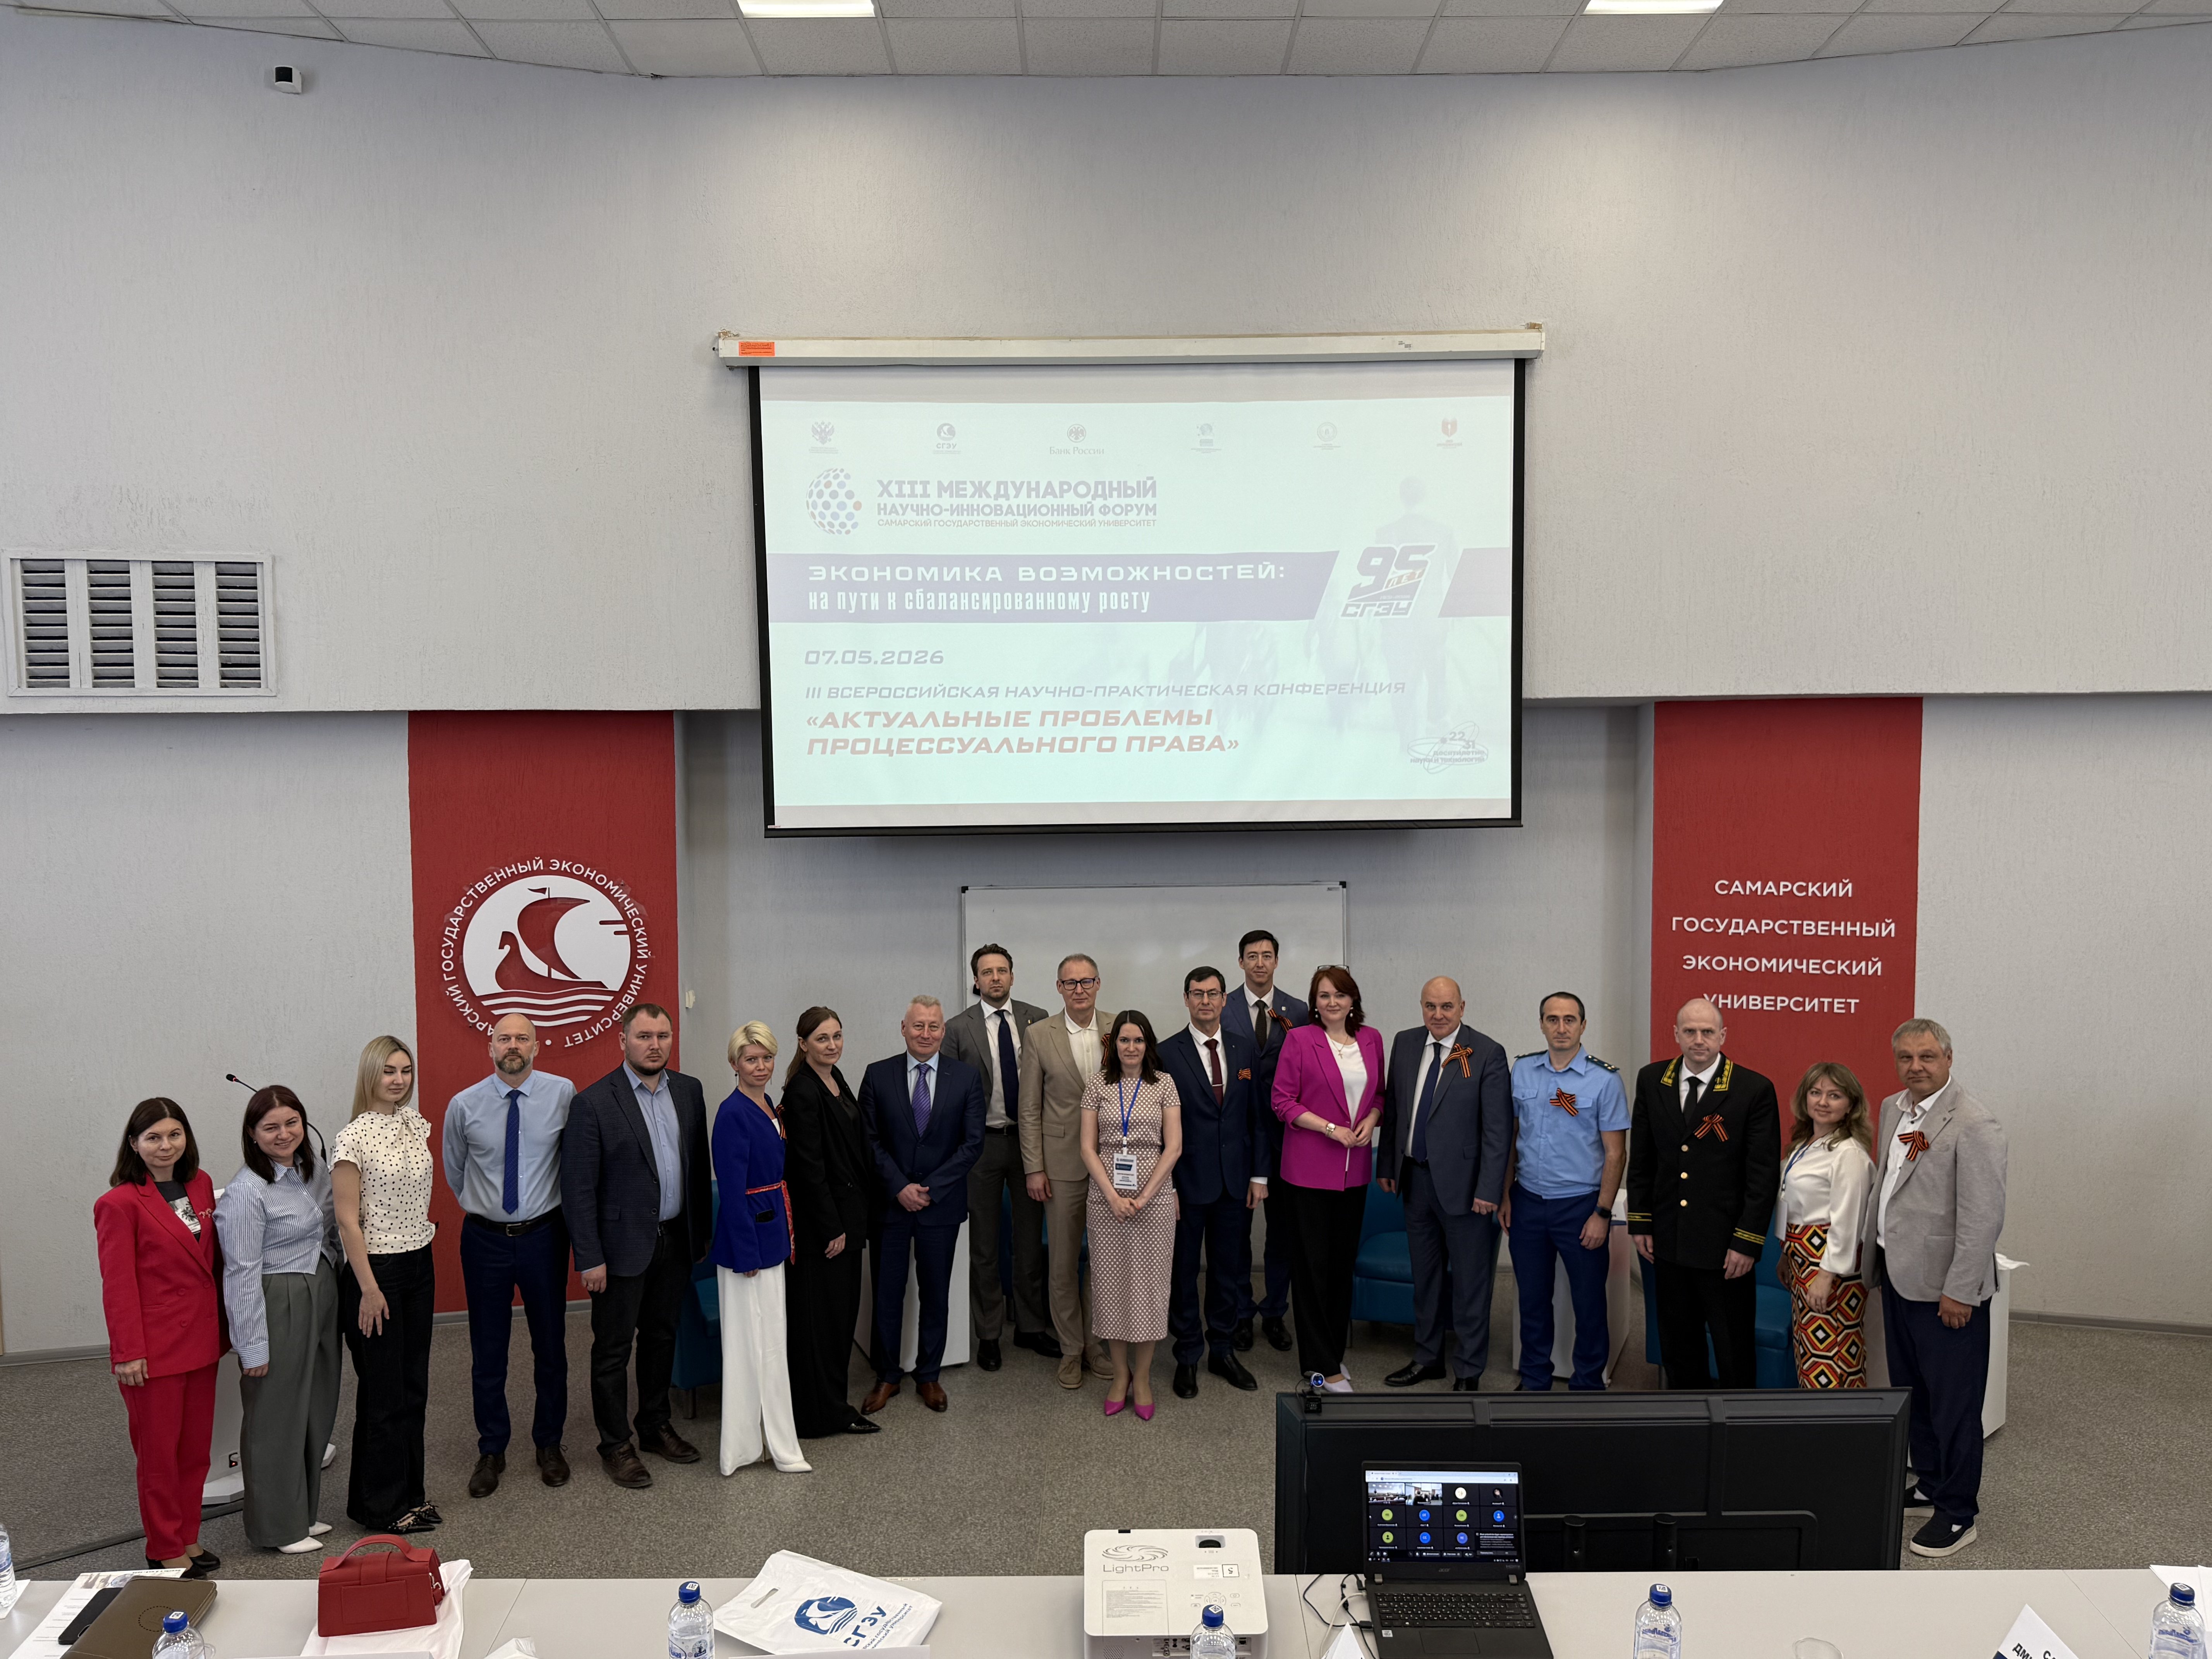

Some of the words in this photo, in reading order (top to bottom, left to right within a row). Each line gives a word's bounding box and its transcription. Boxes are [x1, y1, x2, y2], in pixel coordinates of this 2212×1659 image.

[1049, 446, 1071, 455] Банк
[1073, 446, 1104, 455] России
[876, 479, 931, 498] XIII
[937, 476, 1157, 501] МЕЖДУНАРОДНЫЙ
[877, 501, 1094, 519] НАУЧНО-ИННОВАЦИОННЫЙ
[1098, 503, 1157, 516] ФОРУМ
[877, 519, 932, 527] САМАРСКИЙ
[934, 519, 1018, 528] ГОСУДАРСТВЕННЫЙ
[1020, 519, 1096, 527] ЭКОНОМИЧЕСКИЙ
[1098, 519, 1157, 527] УНИВЕРСИТЕТ
[809, 566, 1003, 581] ЭКОНОМИКА
[1018, 562, 1284, 581] ВОЗМОЖНОСТЕЙ:
[1347, 544, 1436, 601] 95
[809, 591, 828, 610] на
[837, 591, 879, 613] пути
[888, 592, 896, 610] к
[904, 588, 1090, 613] сбалансированному
[1099, 591, 1150, 613] росту
[1341, 601, 1413, 617] СГЭУ
[804, 650, 944, 665] 07.05.2026
[805, 687, 821, 699] III
[827, 683, 1000, 699] ВСЕРОССИЙСКАЯ
[1005, 684, 1248, 698] НАУЧНО-ПРАКТИЧЕСКАЯ
[1253, 682, 1406, 696] КОНФЕРЕНЦИЯ
[806, 711, 1031, 728] «АКТУАЛЬНЫЕ
[1039, 709, 1212, 727] ПРОБЛЕМЫ
[807, 737, 1117, 757] ПРОЦЕССУАЛЬНОГО
[1125, 735, 1239, 752] ПРАВА»
[1449, 731, 1465, 741] 22
[1714, 878, 1853, 898] САМАРСКИЙ
[441, 856, 544, 981] ГОСУДАРСТВЕННЫЙ
[549, 859, 651, 959] ЭКОНОМИЧЕСКИЙ
[1671, 916, 1896, 938] ГОСУДАРСТВЕННЫЙ
[1682, 955, 1882, 976] ЭКОНОМИЧЕСКИЙ
[445, 984, 495, 1036] АРСКИЙ
[564, 963, 647, 1048] УНИВЕРСИТЕТ
[1703, 993, 1860, 1013] УНИВЕРСИТЕТ
[1103, 1564, 1169, 1574] LightPro
[843, 1606, 886, 1647] СГЭУ
